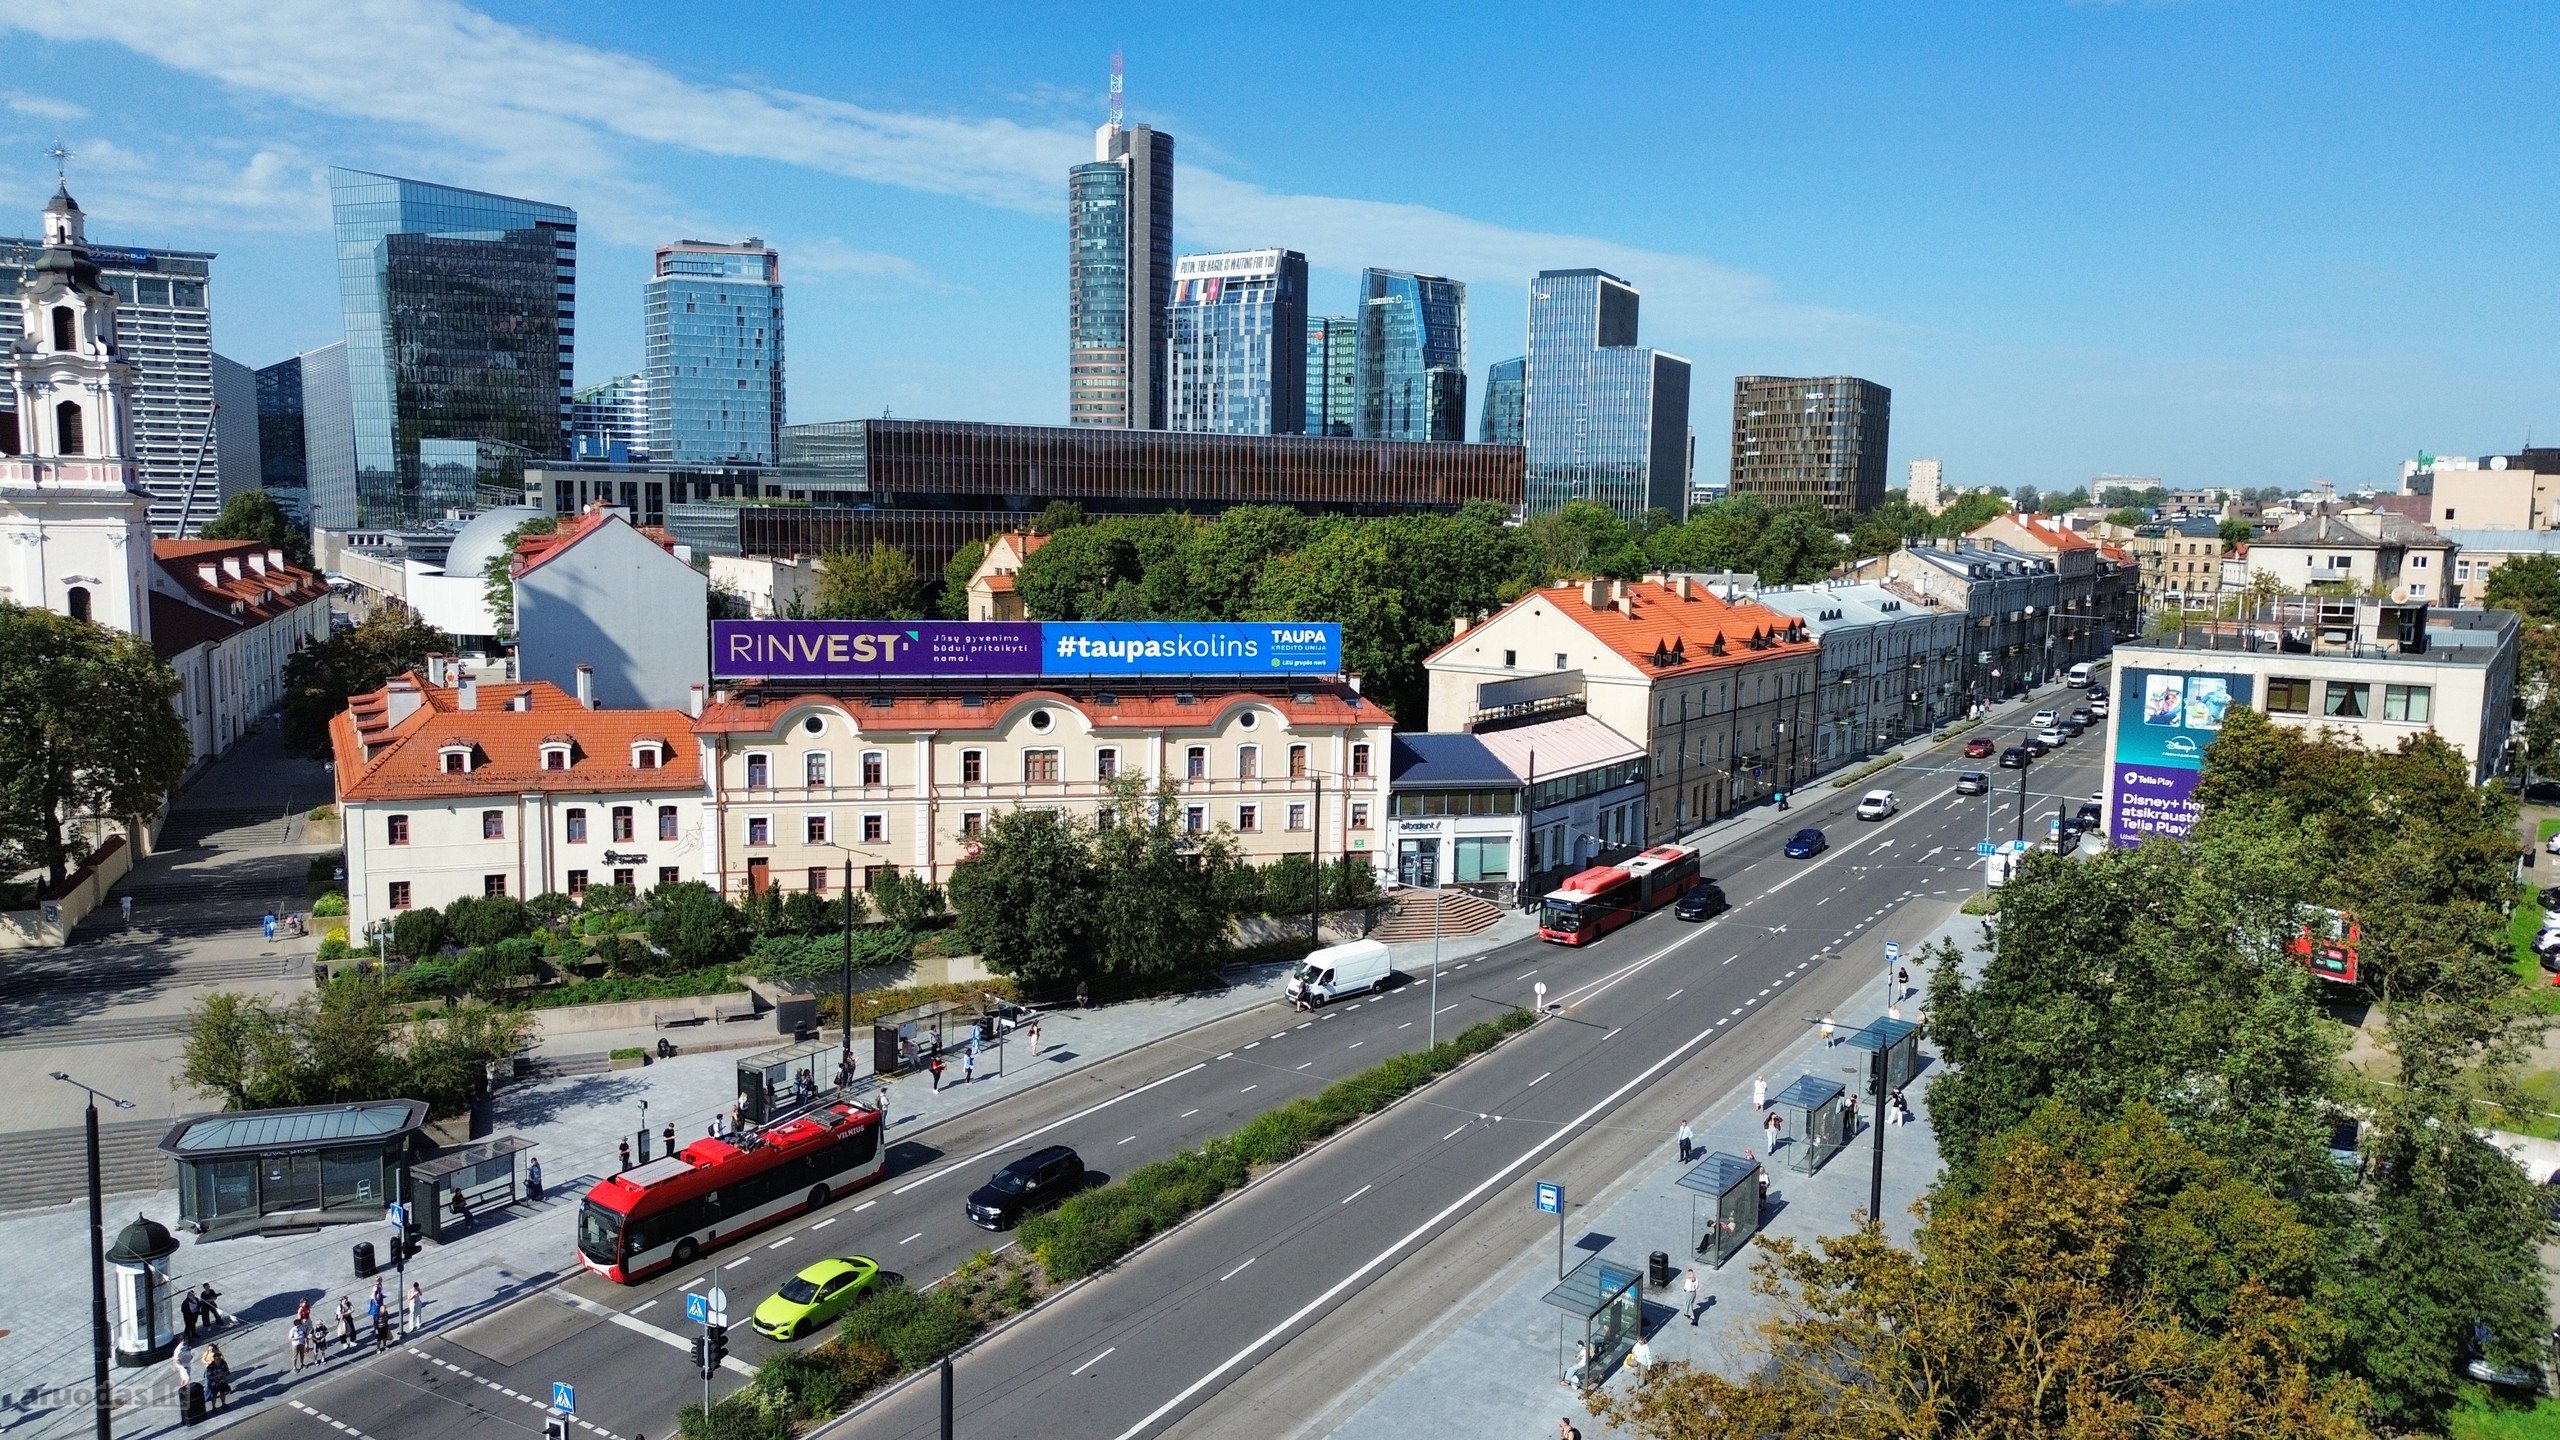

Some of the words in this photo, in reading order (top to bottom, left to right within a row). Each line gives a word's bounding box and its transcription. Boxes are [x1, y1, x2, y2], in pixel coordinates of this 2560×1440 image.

[1197, 260, 1208, 272] THE
[1207, 259, 1224, 272] HAGUE
[1224, 258, 1231, 271] IS
[1230, 257, 1253, 271] WAITING
[1253, 256, 1264, 269] FOR
[1264, 255, 1276, 268] YOU
[933, 634, 960, 643] Jūsų
[965, 634, 1020, 643] gyvenimo
[1271, 630, 1327, 643] TAUPA
[730, 633, 901, 662] RINVEST
[933, 644, 966, 652] būdui
[971, 644, 1028, 653] pritaikyti
[1057, 633, 1258, 663] #taupaskolins
[933, 654, 973, 662] namai.
[2164, 736, 2197, 753] Disney+
[2138, 775, 2157, 785] Telia
[2157, 777, 2175, 788] Play
[2123, 793, 2180, 811] Disney+
[2121, 818, 2153, 831] Telia
[837, 1124, 865, 1140] VILNIUS
